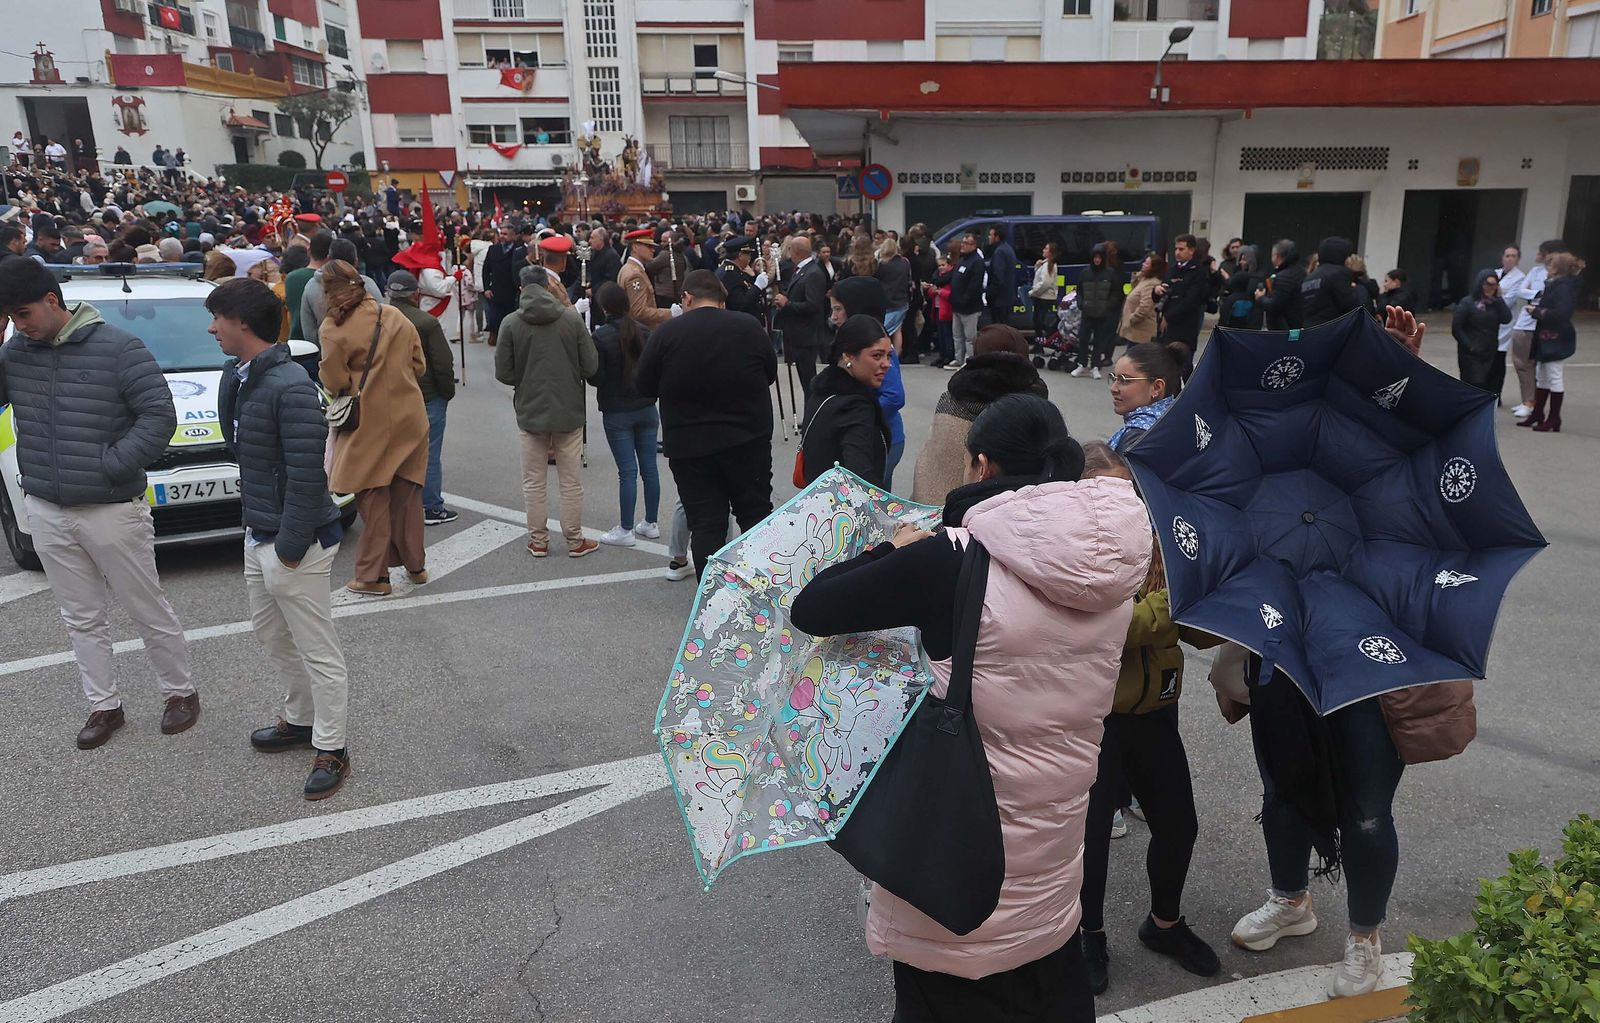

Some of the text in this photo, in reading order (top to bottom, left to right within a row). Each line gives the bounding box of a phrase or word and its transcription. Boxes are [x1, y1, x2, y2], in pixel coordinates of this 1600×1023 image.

[188, 428, 207, 436] KIA
[169, 479, 241, 500] 3747 LS
